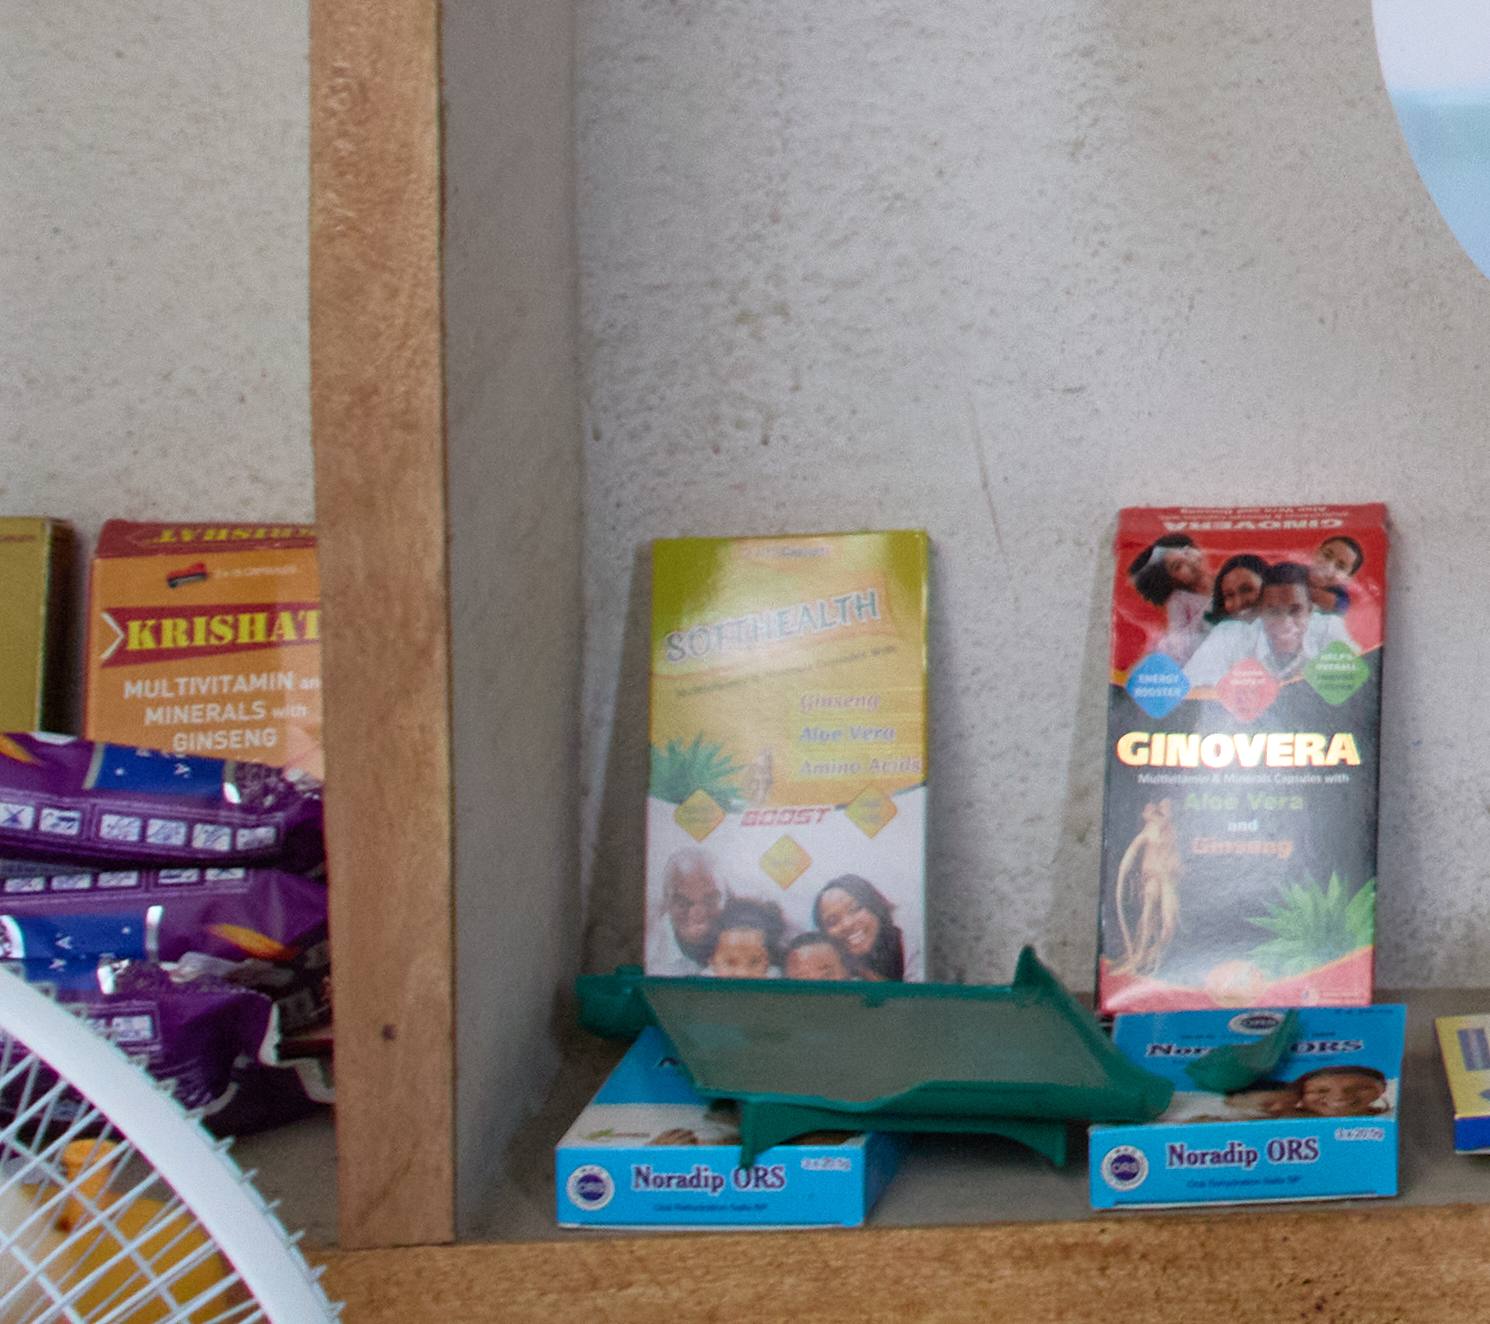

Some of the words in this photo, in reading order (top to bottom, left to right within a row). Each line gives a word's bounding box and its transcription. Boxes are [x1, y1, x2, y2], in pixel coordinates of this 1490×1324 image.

[126, 610, 321, 651] KRISHAT
[665, 588, 881, 664] SOFTHEALTH
[124, 671, 293, 698] MULTIVITAMIN
[145, 701, 266, 725] MINERALS
[272, 705, 306, 718] with
[800, 694, 881, 714] Ginseng
[173, 728, 277, 751] GINSENG
[800, 727, 842, 743] Aloe
[850, 726, 895, 741] Vera
[1117, 731, 1361, 768] GINOVERA
[739, 806, 831, 827] BOOST
[1227, 819, 1259, 832] and
[1167, 1143, 1258, 1168] Noradip
[1267, 1138, 1320, 1162] ORS
[633, 1165, 725, 1193] Noradip
[733, 1165, 786, 1190] ORS
